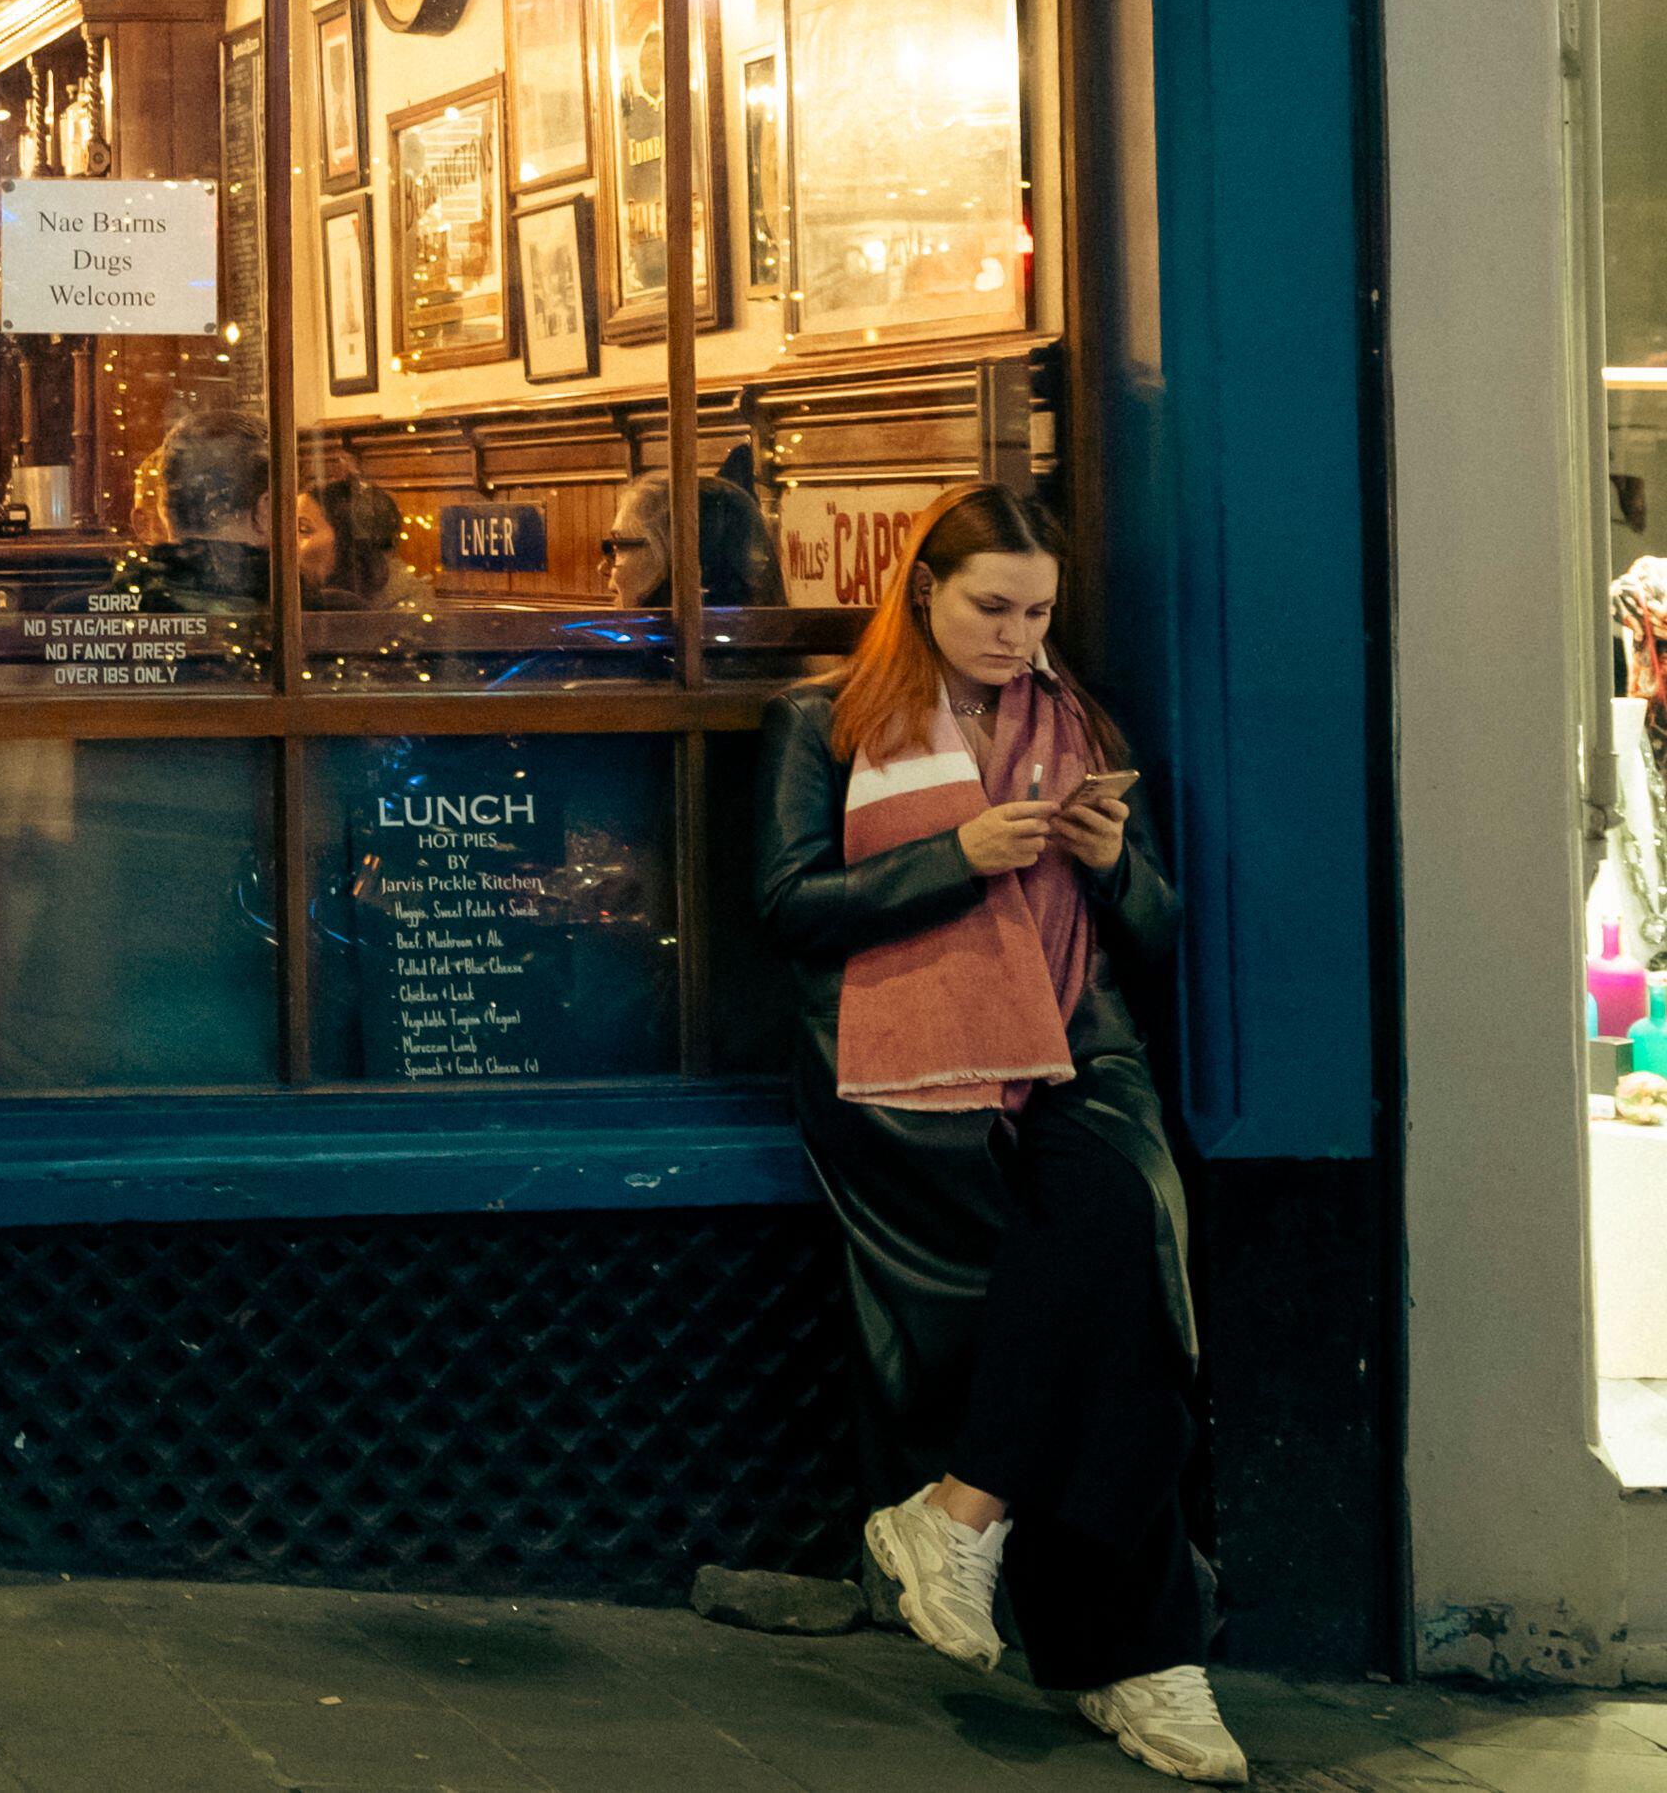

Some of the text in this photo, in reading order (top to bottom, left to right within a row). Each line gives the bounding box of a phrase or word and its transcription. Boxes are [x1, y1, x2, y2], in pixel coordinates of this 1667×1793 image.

[37, 210, 167, 235] Nae Bairns
[71, 249, 133, 278] Dugs
[48, 285, 157, 308] Welcome
[88, 594, 143, 612] SORRY
[23, 617, 207, 637] NO STAG/HEN PARTIES
[45, 642, 187, 661] NO FANCY DRESS
[53, 667, 99, 685] OVER
[134, 667, 178, 684] ONLY
[377, 793, 535, 827] LUNCH
[418, 832, 498, 849] HOT PIES
[448, 854, 470, 870] BY
[381, 873, 542, 895] Jarvis Pickle Kitchen
[433, 899, 463, 919] Sweet
[466, 898, 496, 918] Potato
[509, 898, 540, 917] Swede
[426, 929, 473, 949] Mushroom
[486, 929, 505, 947] Ale
[397, 957, 428, 976] Pulled
[430, 956, 452, 975] Pork
[464, 957, 486, 975] Blue
[489, 956, 524, 974] Cheese
[399, 982, 439, 1002] Chicken
[450, 982, 475, 1002] Leek
[401, 1009, 448, 1037] Vegetable
[483, 1008, 521, 1033] (Vegan)
[402, 1035, 478, 1054] Moroccan Lamb
[404, 1057, 444, 1082] Spinach
[485, 1056, 521, 1075] Cheese
